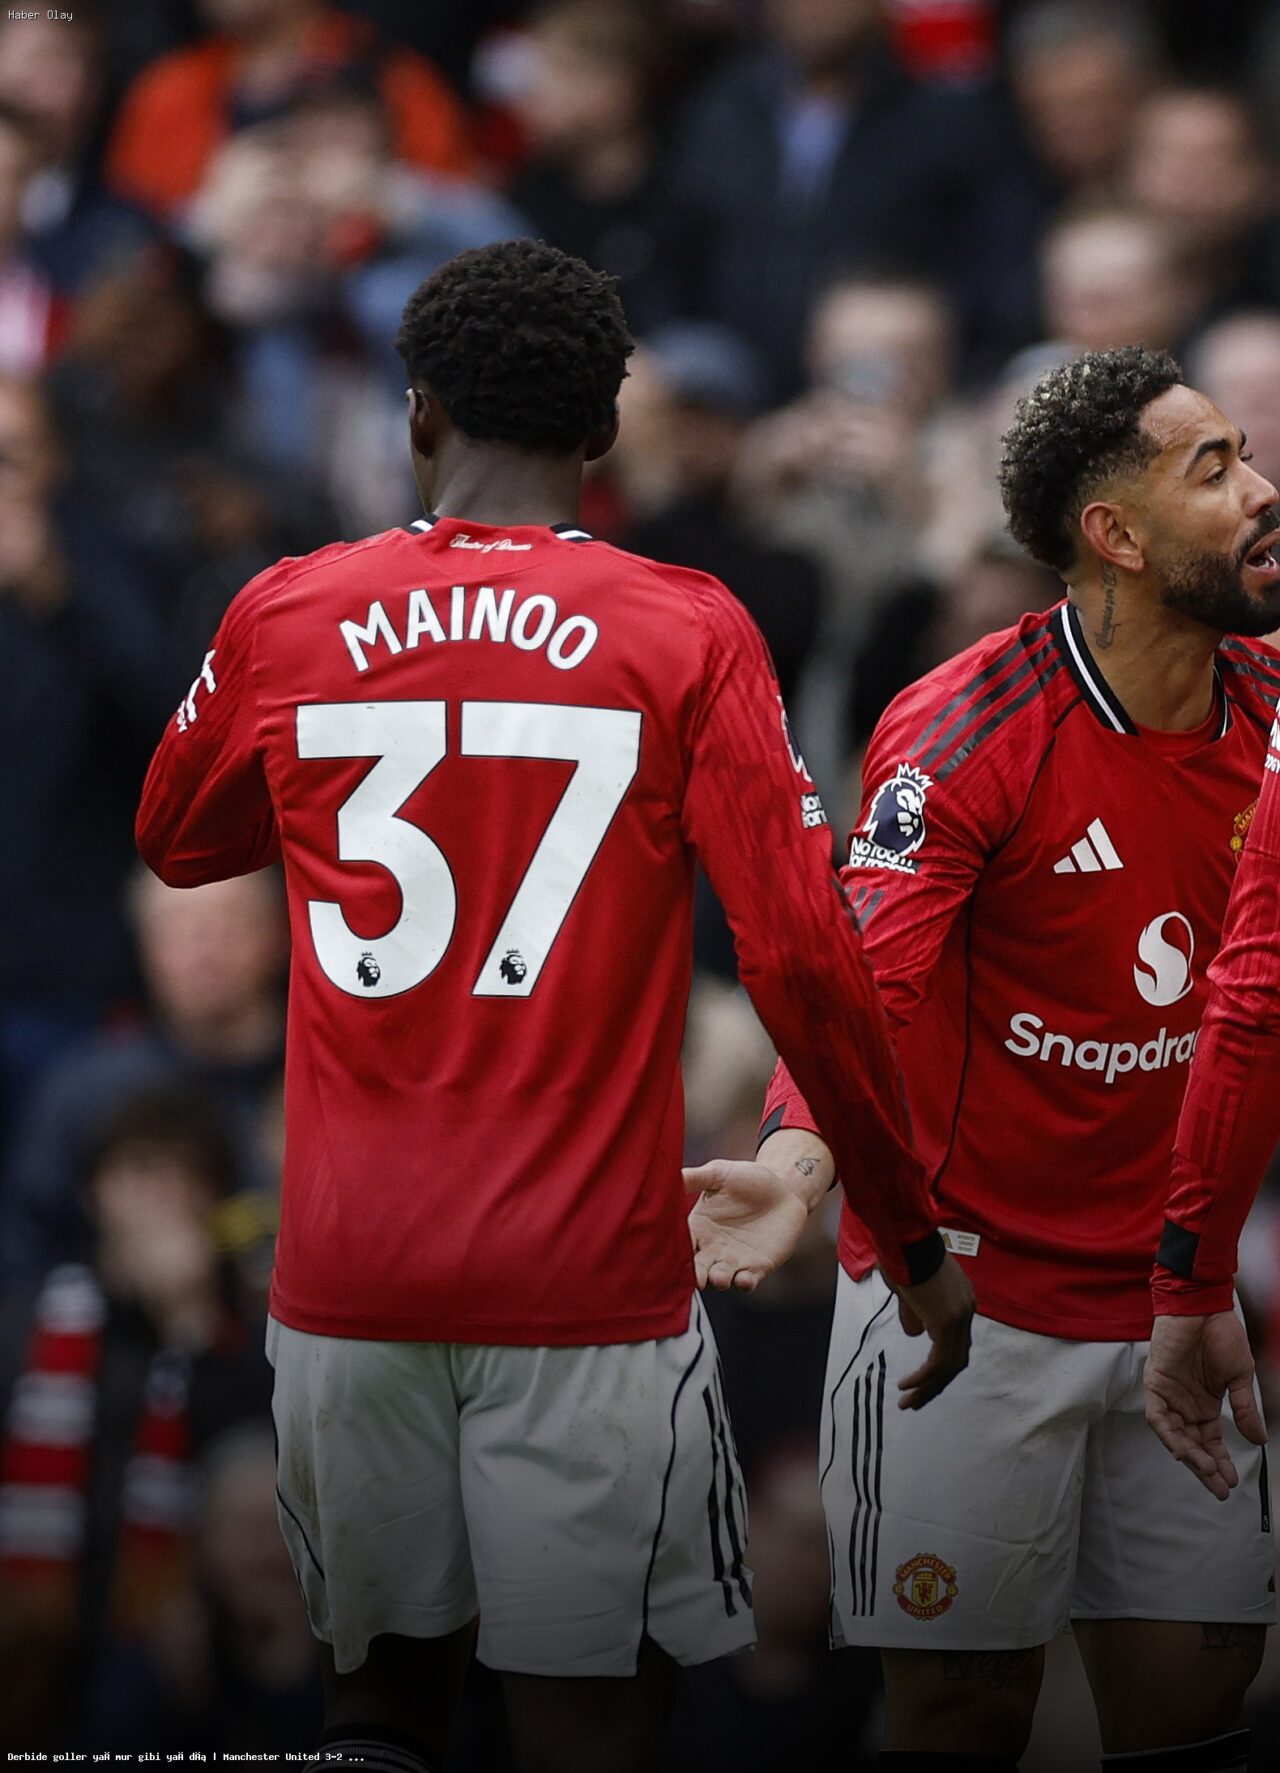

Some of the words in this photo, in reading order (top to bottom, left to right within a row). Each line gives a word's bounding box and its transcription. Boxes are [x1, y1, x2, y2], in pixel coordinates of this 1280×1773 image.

[338, 585, 600, 674] MAINOO
[295, 699, 644, 999] 37
[1004, 1012, 1200, 1084] Snapdra
